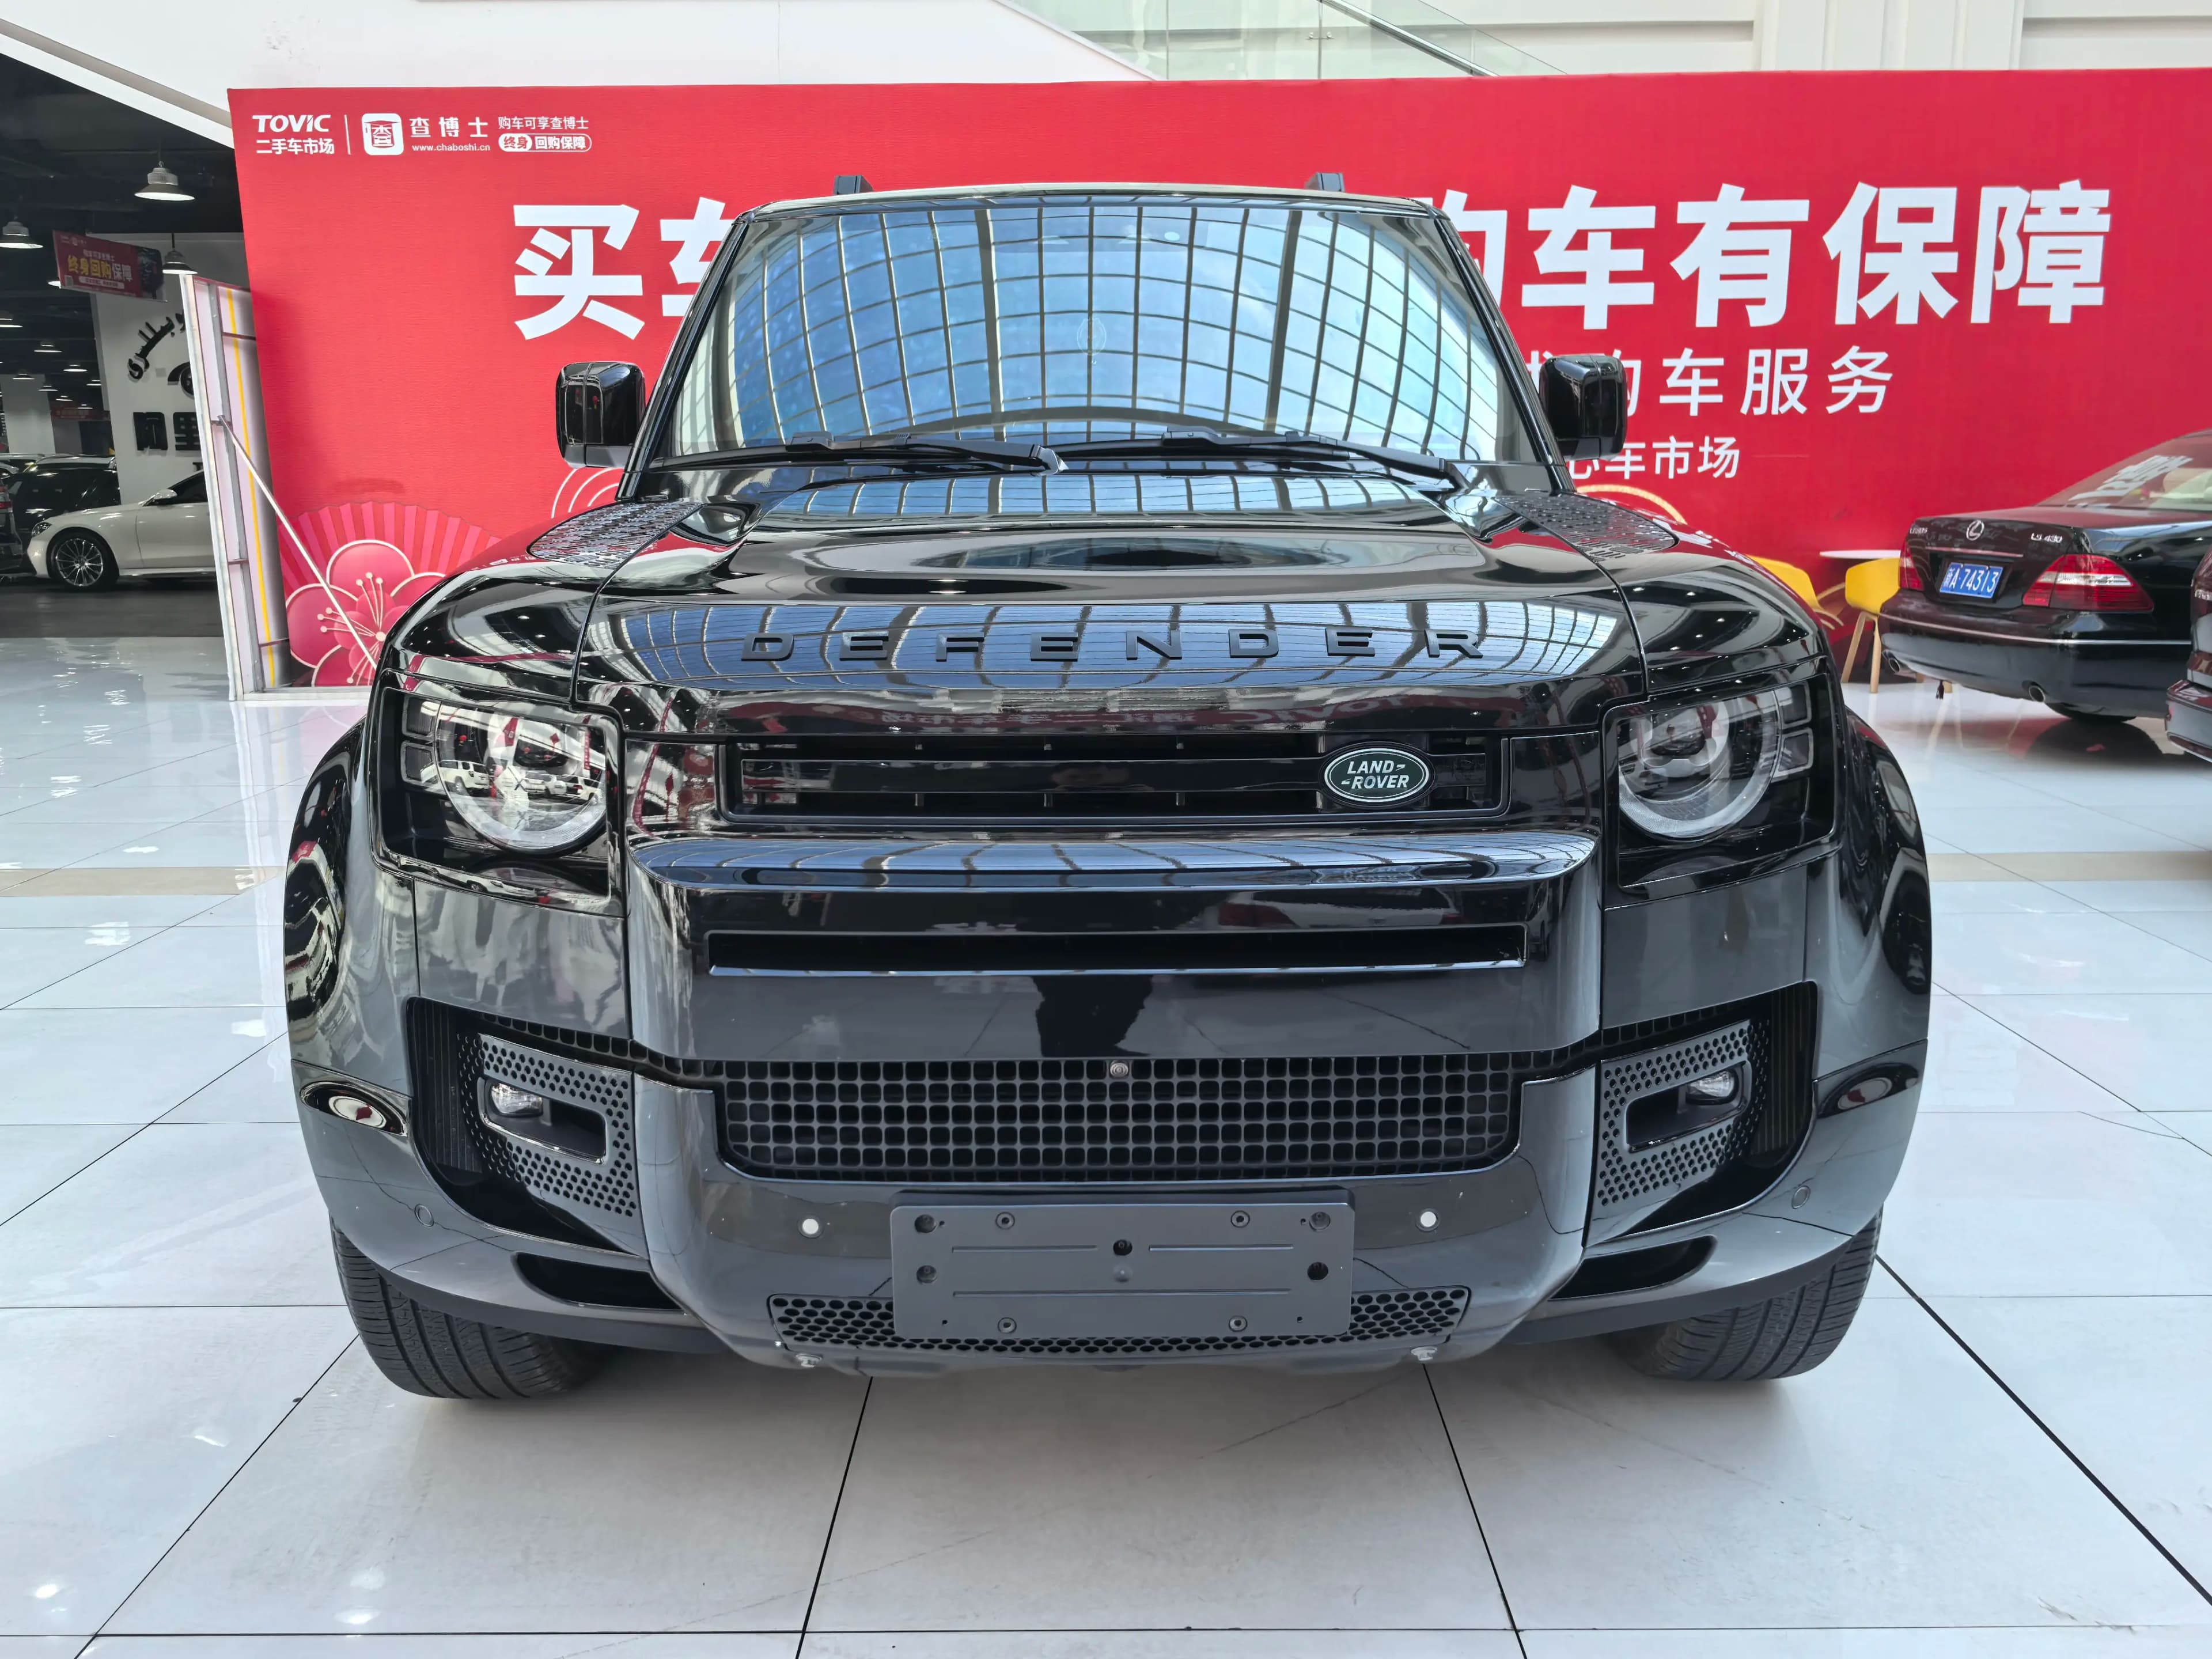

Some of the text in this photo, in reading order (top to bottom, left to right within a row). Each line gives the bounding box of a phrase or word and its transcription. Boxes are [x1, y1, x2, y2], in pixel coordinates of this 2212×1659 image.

[252, 115, 331, 132] TOVIC
[409, 117, 488, 137] 查博士
[498, 116, 589, 129] 购车可享查博士
[256, 138, 335, 155] 二手车市场
[412, 143, 490, 151] www.chaboshi.cn
[1525, 345, 1895, 416] 车服务
[741, 627, 1484, 662] DEFENDER
[1347, 760, 1395, 774] LAND
[1351, 775, 1410, 789] ROVER
